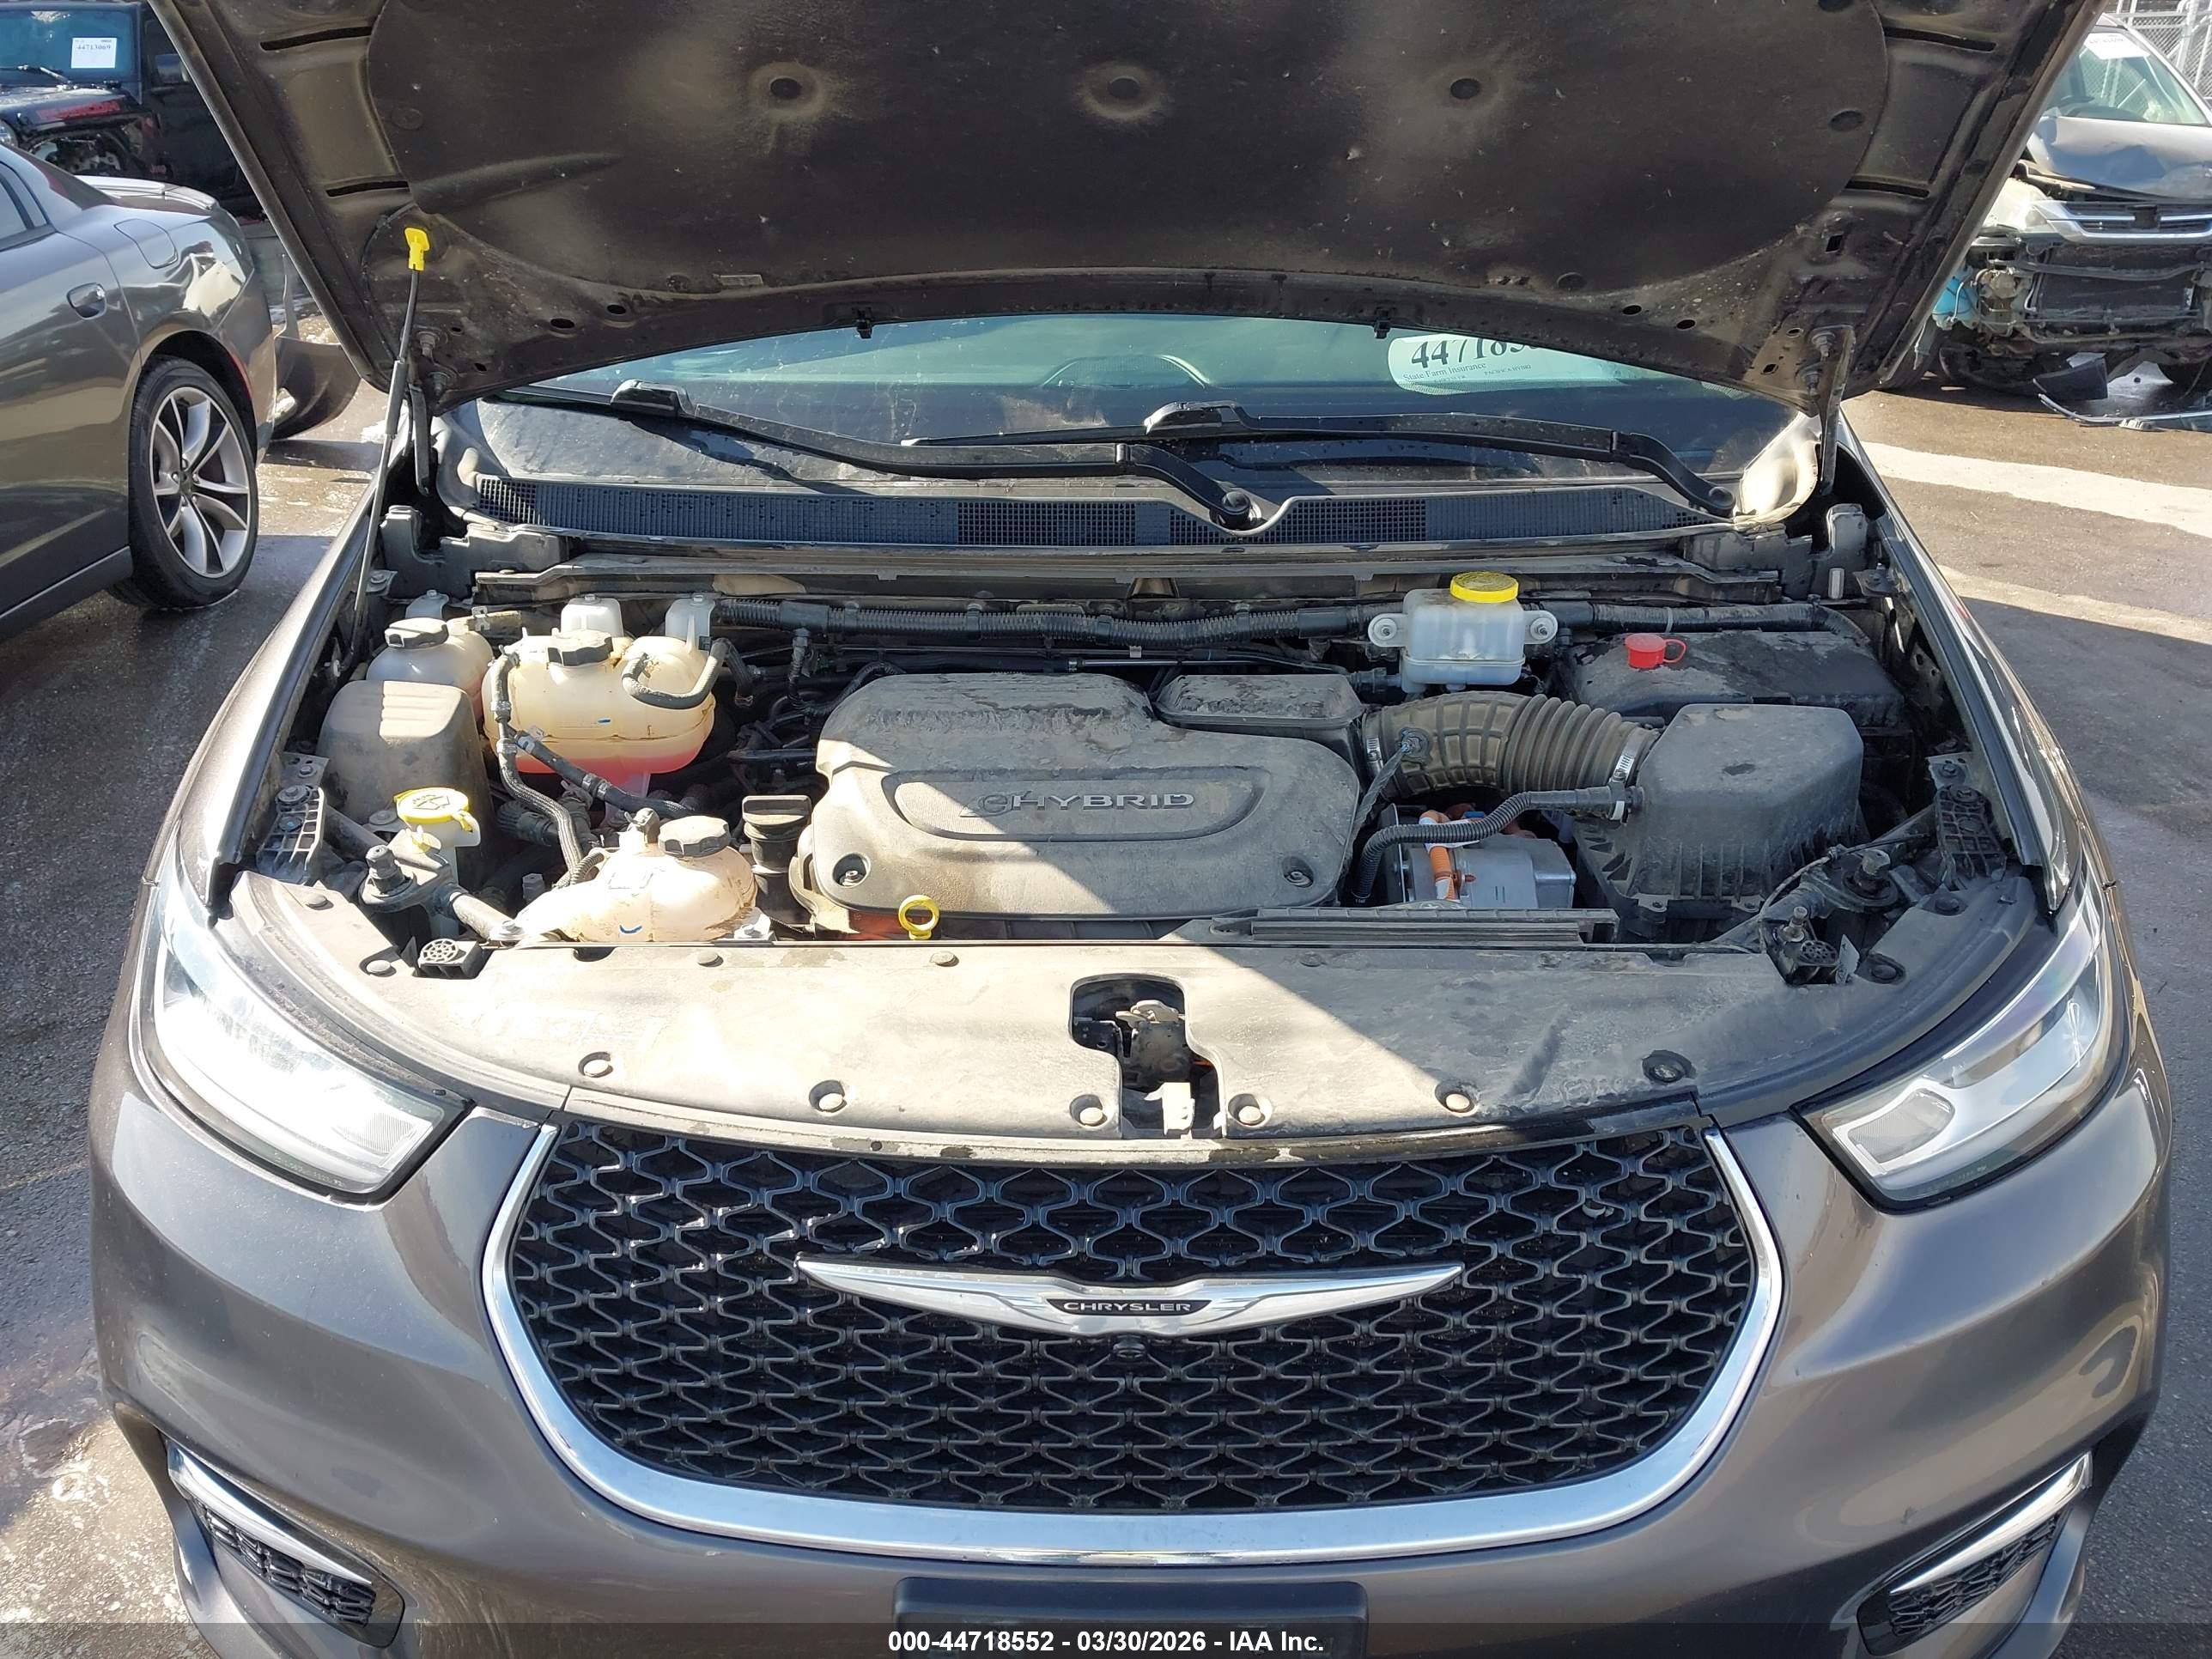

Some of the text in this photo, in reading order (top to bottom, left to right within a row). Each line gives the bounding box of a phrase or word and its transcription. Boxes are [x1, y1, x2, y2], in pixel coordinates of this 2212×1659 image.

[1425, 369, 1447, 378] Farm
[1448, 362, 1487, 374] Insurance
[1063, 1302, 1191, 1312] CHRYSLER
